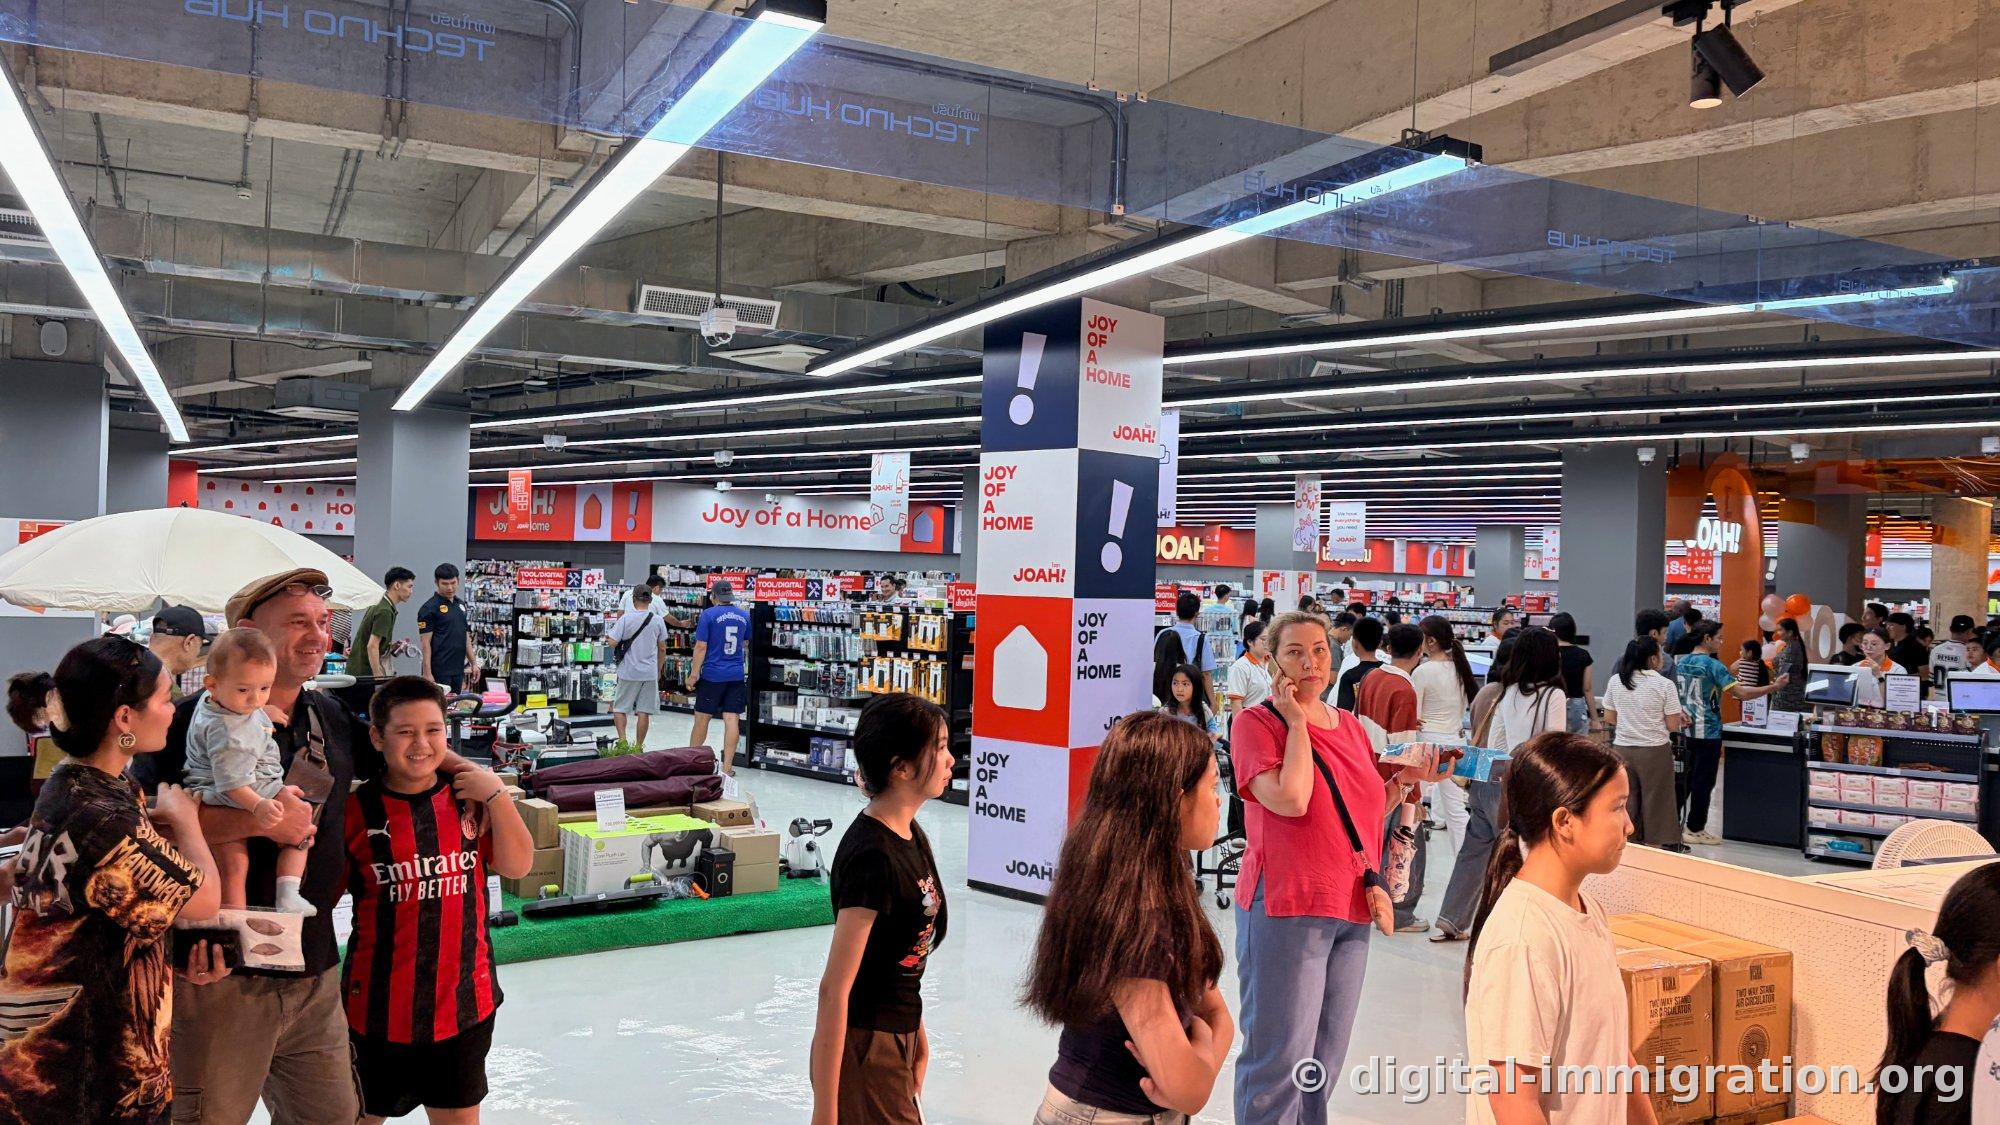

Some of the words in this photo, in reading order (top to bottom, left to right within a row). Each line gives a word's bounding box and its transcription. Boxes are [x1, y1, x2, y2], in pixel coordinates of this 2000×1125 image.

[1087, 314, 1118, 333] JOY
[1087, 332, 1107, 348] OF
[1086, 349, 1098, 365] A
[1086, 367, 1131, 388] HOME
[1112, 424, 1156, 444] JOAH!
[984, 465, 1017, 481] JOY
[984, 482, 1006, 497] OF
[326, 502, 355, 516] HO
[983, 500, 995, 514] A
[702, 502, 746, 530] Joy
[755, 500, 781, 526] of
[786, 511, 801, 528] a
[807, 508, 871, 531] Home
[983, 516, 1034, 531] HOME
[493, 521, 509, 533] Joy
[532, 521, 551, 532] ome
[1685, 518, 1742, 554] OAH!
[1013, 567, 1067, 584] JOAH!
[1078, 612, 1108, 628] JOY
[724, 626, 738, 655] 5
[1077, 630, 1098, 645] OF
[1077, 648, 1088, 662] A
[1077, 664, 1121, 680] HOME
[976, 751, 1010, 768] JOY
[976, 768, 998, 783] OF
[975, 785, 988, 800] A
[975, 801, 1026, 823] HOME
[93, 834, 192, 914] MANOWAR
[370, 850, 479, 885] Emirates
[1005, 859, 1054, 883] JOAH
[389, 882, 413, 903] FLY
[417, 874, 468, 901] BETTER
[1674, 995, 1692, 1005] STAND
[1745, 993, 1775, 1007] CIRCULATOR
